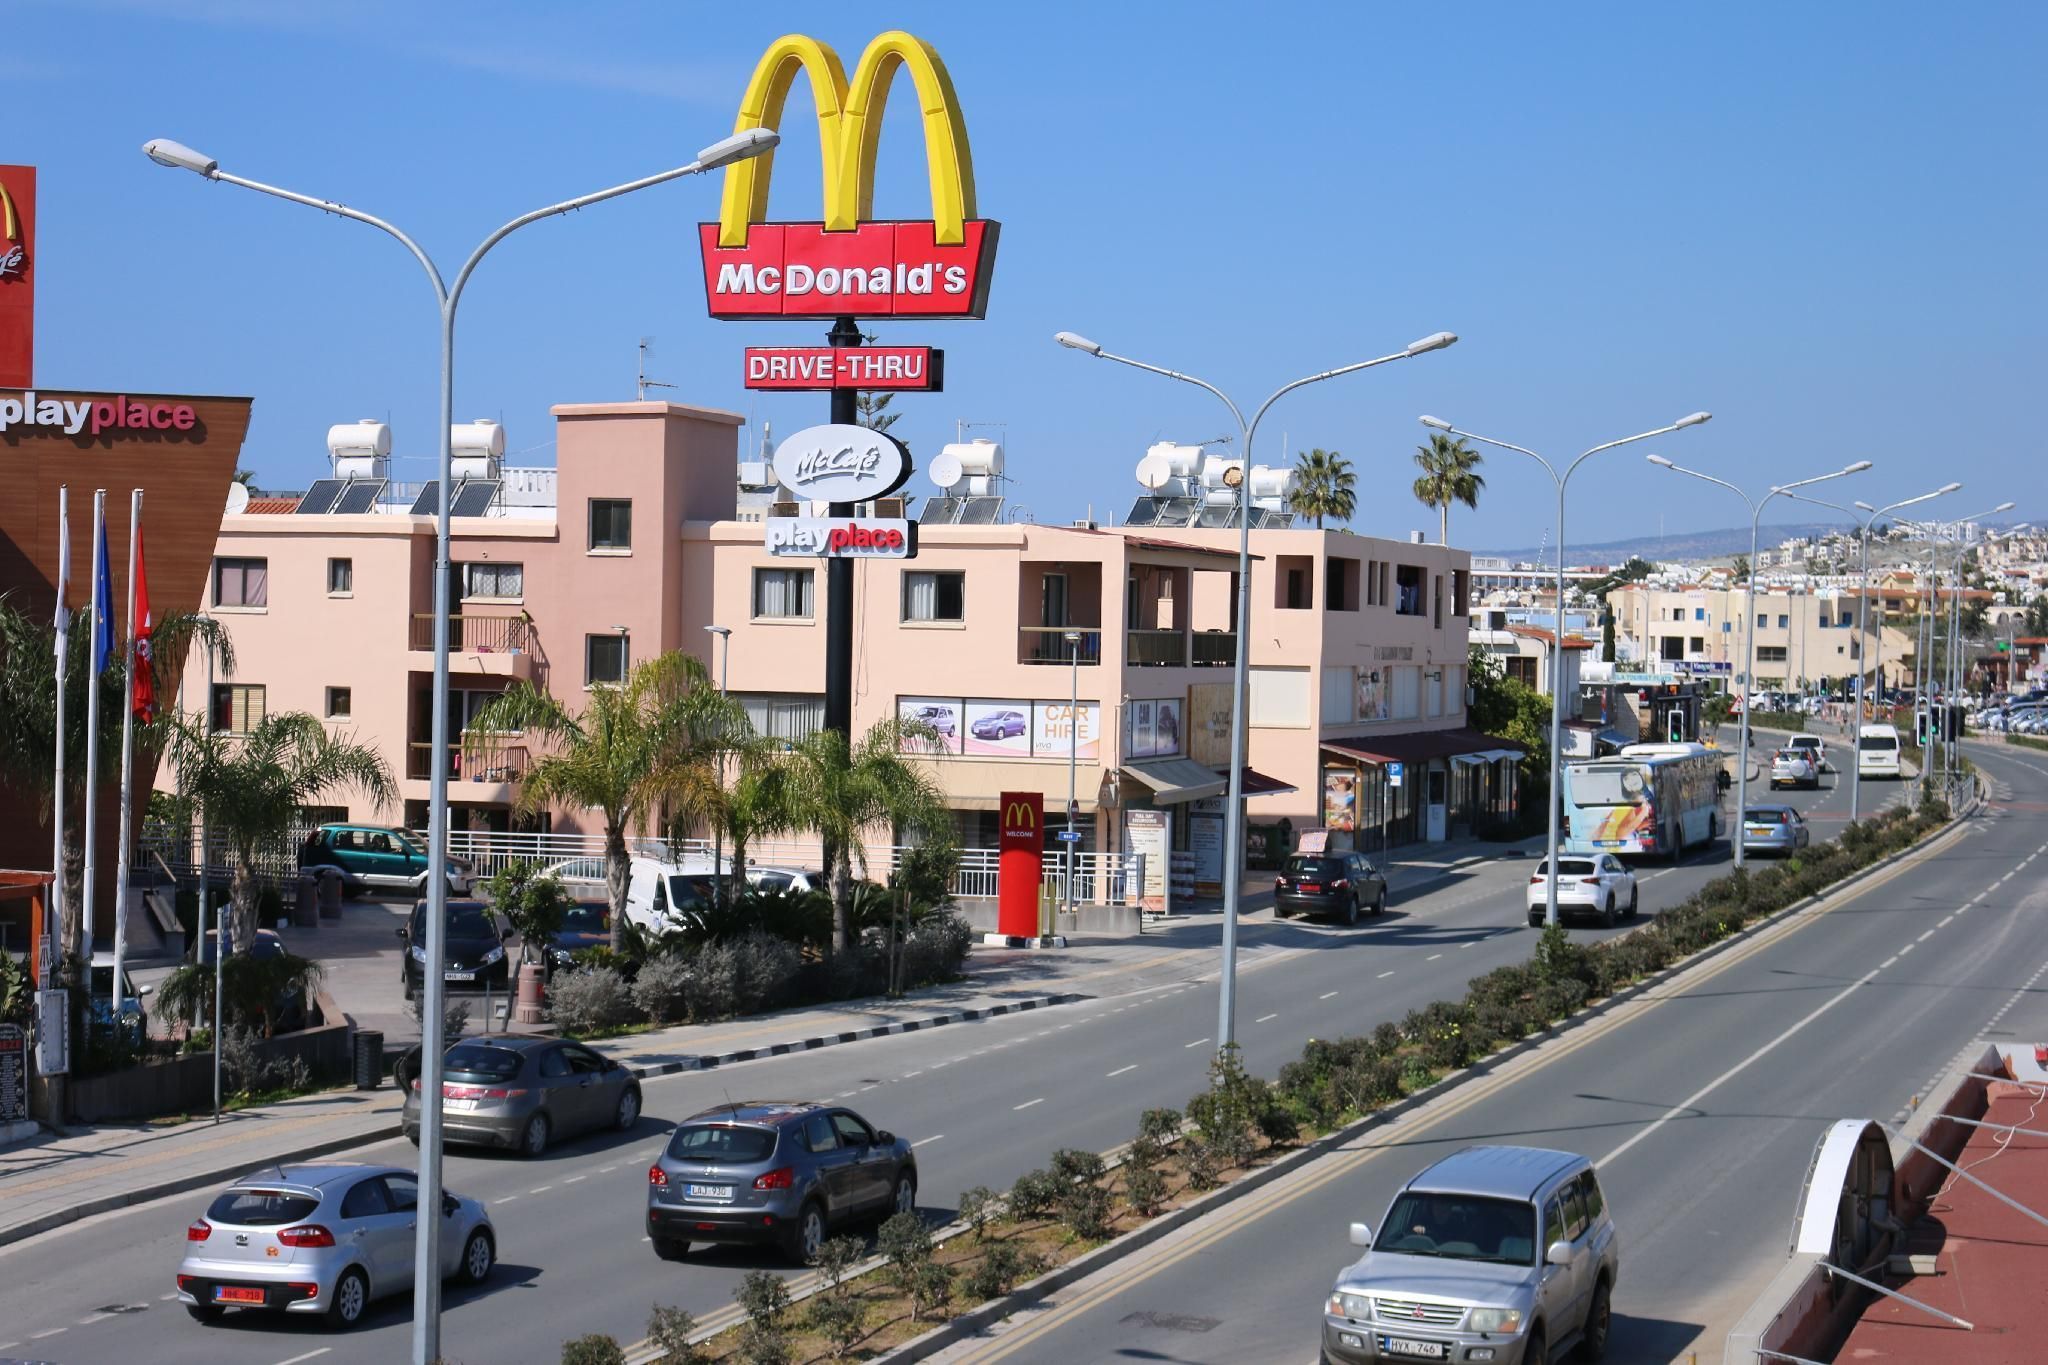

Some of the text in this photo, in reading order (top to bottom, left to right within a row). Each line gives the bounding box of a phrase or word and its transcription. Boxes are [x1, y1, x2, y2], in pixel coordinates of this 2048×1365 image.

[715, 263, 967, 296] McDonald's
[749, 355, 924, 381] DRIVE-THRU
[767, 522, 904, 554] playplace
[1045, 703, 1089, 722] CAR
[1005, 830, 1035, 838] WELCOME
[692, 1184, 707, 1195] LAJ
[1391, 1340, 1436, 1354] HYX 746
